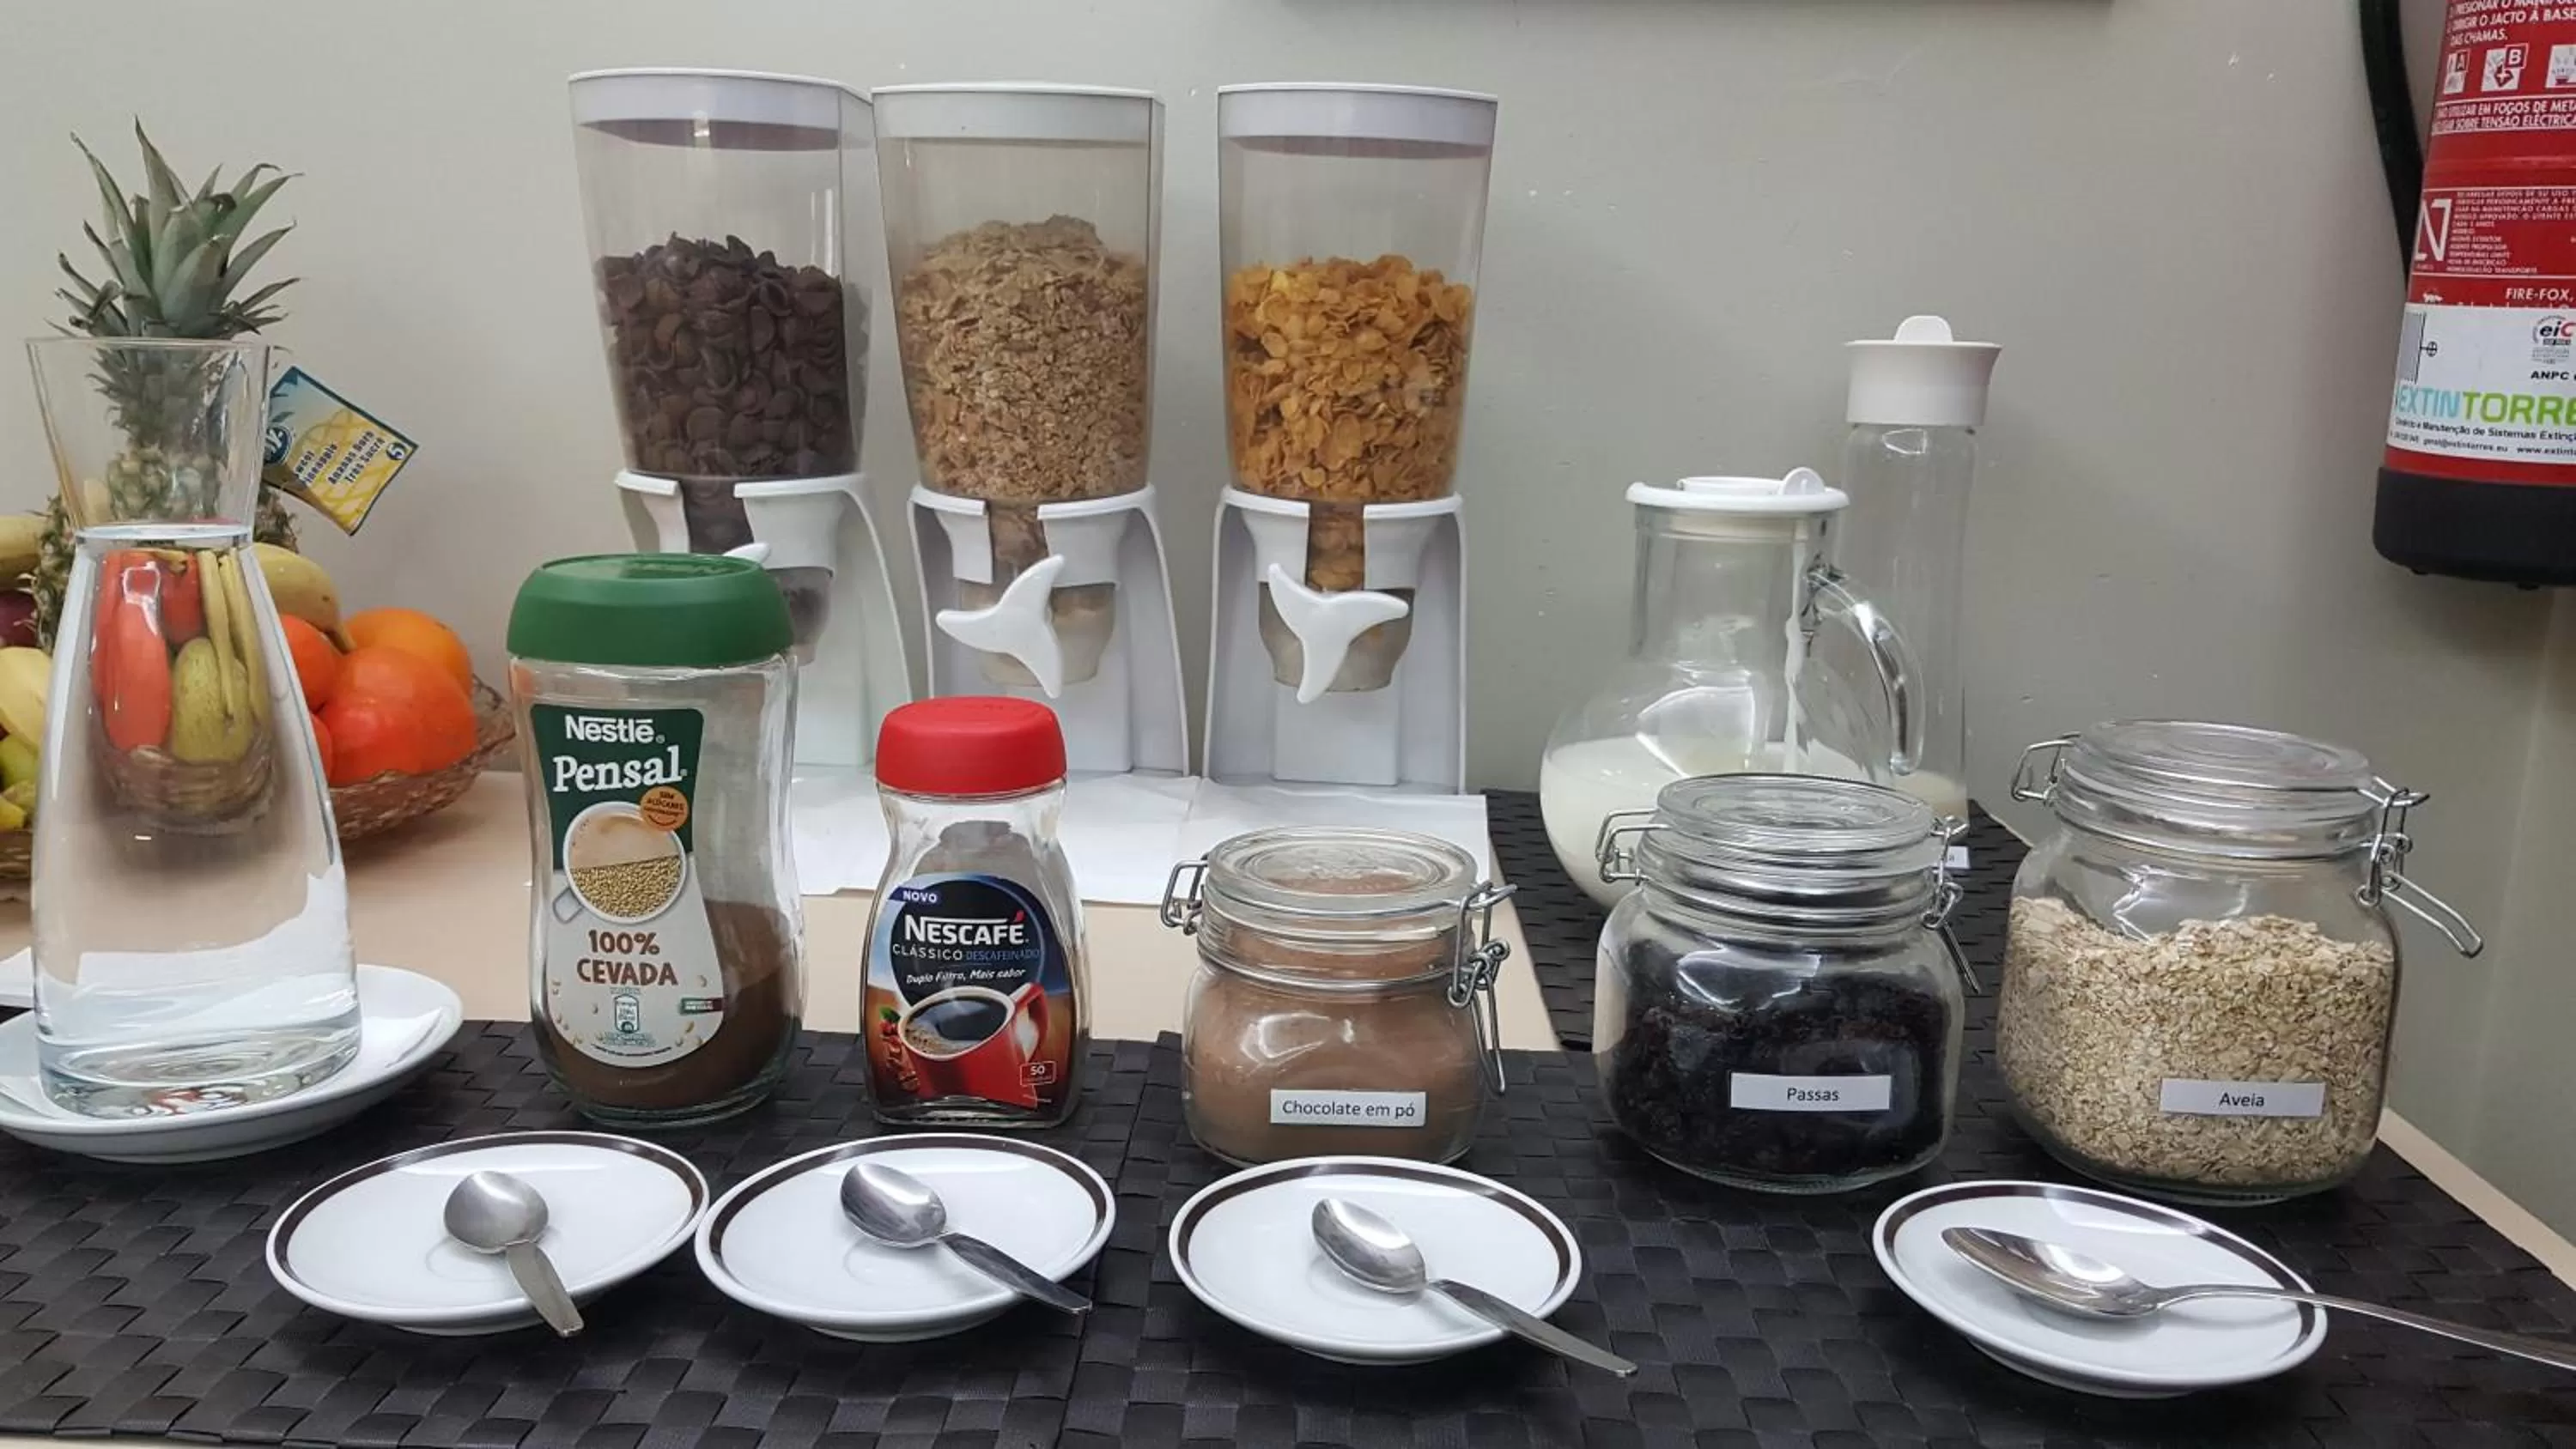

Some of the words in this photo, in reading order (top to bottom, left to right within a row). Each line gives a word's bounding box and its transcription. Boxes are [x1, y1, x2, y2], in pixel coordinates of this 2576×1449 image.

[2479, 15, 2488, 27] O
[2489, 10, 2526, 25] JACTO
[2543, 7, 2576, 21] BASE
[2507, 48, 2523, 66] B
[2493, 100, 2530, 115] FOGOS
[2533, 100, 2548, 112] DE
[2530, 370, 2570, 381] ANPC
[2472, 427, 2486, 437] de
[2488, 427, 2537, 440] Sistemas
[2539, 430, 2576, 444] Extinç
[552, 744, 683, 792] Pensal
[902, 890, 938, 903] NOVO
[904, 909, 1026, 946] NESCAFÉ
[588, 929, 660, 955] 100%
[892, 943, 963, 961] CLÁSSICO
[965, 948, 1040, 961] DESCAFEINADO
[577, 958, 678, 986] CEVADA
[906, 973, 933, 985] Duplo
[969, 969, 996, 980] Mais
[997, 967, 1027, 978] sabor
[1030, 1065, 1045, 1076] 50
[1787, 1087, 1841, 1102] Passas
[2219, 1091, 2266, 1107] Aveia
[1282, 1100, 1361, 1116] Chocolate
[1364, 1104, 1390, 1117] em
[1394, 1102, 1415, 1119] pó
